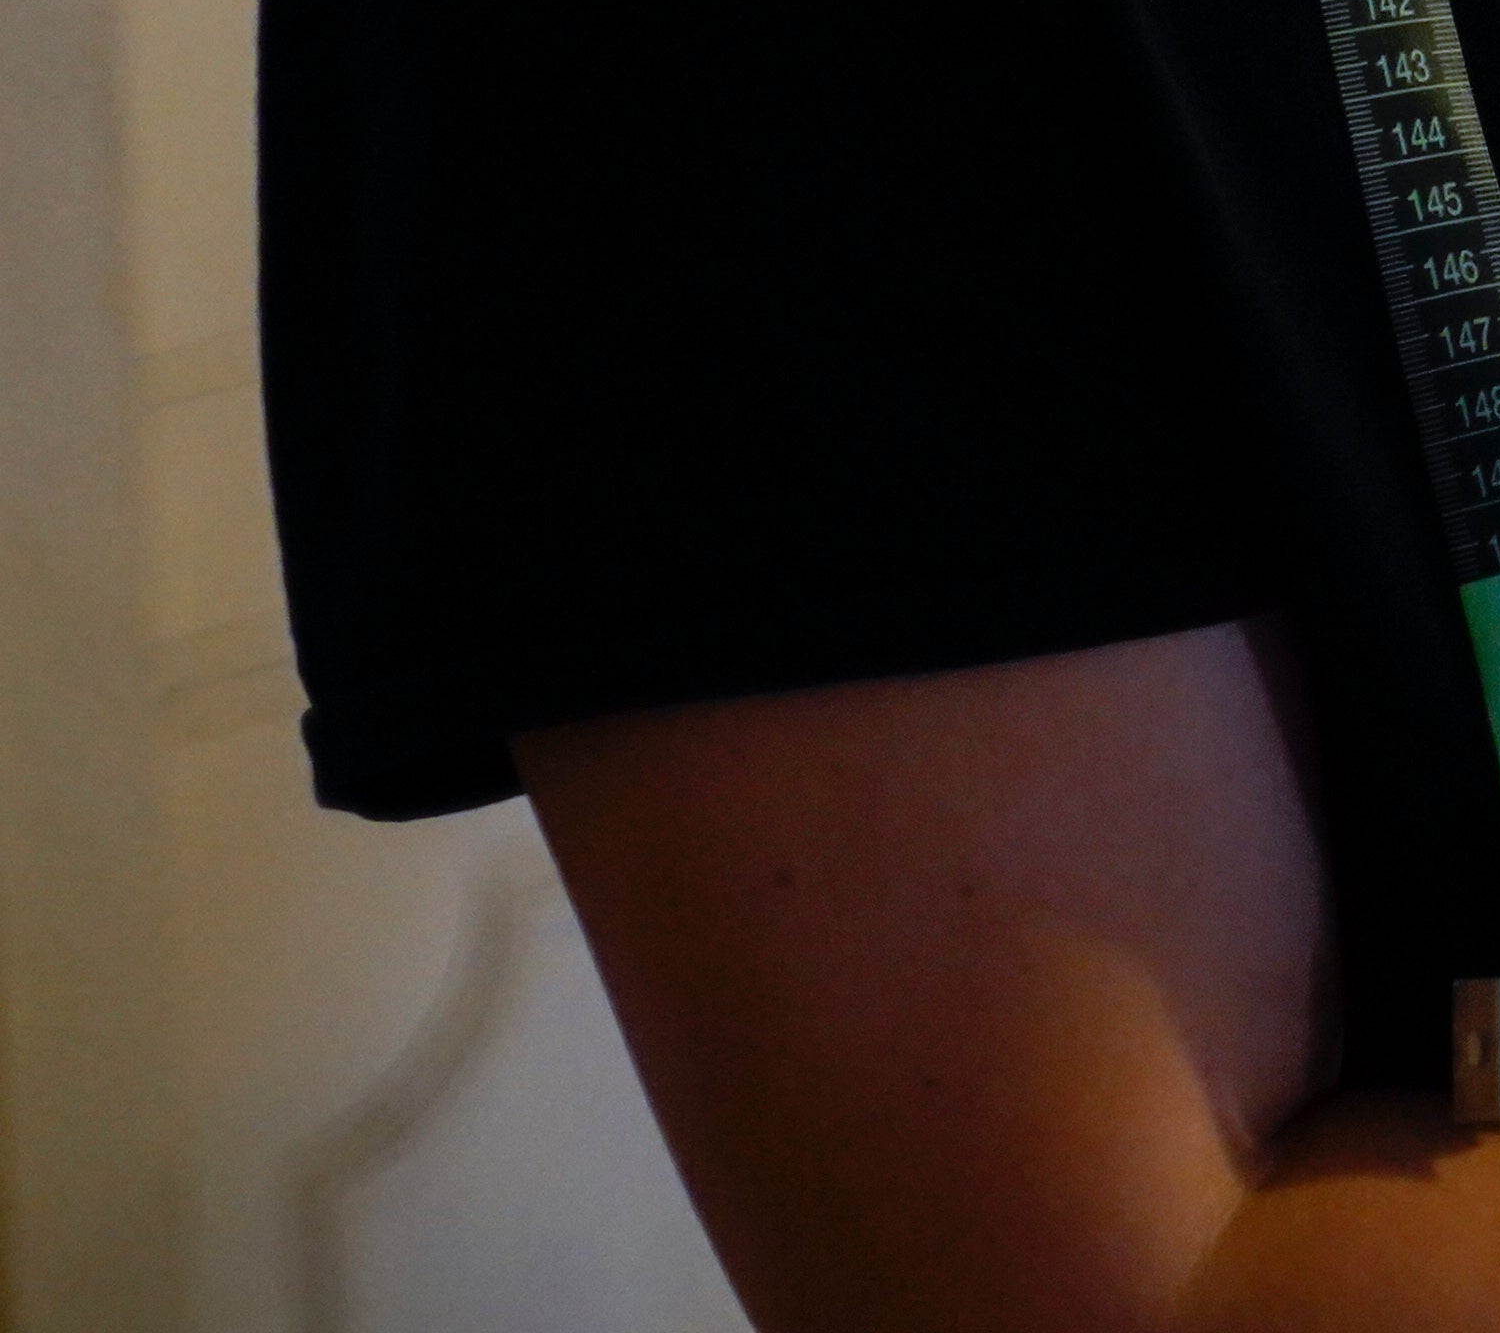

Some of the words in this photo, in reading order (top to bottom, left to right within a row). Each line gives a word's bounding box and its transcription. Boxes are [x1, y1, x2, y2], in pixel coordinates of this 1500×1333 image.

[1375, 49, 1430, 89] 143
[1391, 116, 1446, 153] 144
[1406, 183, 1464, 222] 145
[1423, 250, 1480, 290] 146
[1439, 316, 1493, 357] 147
